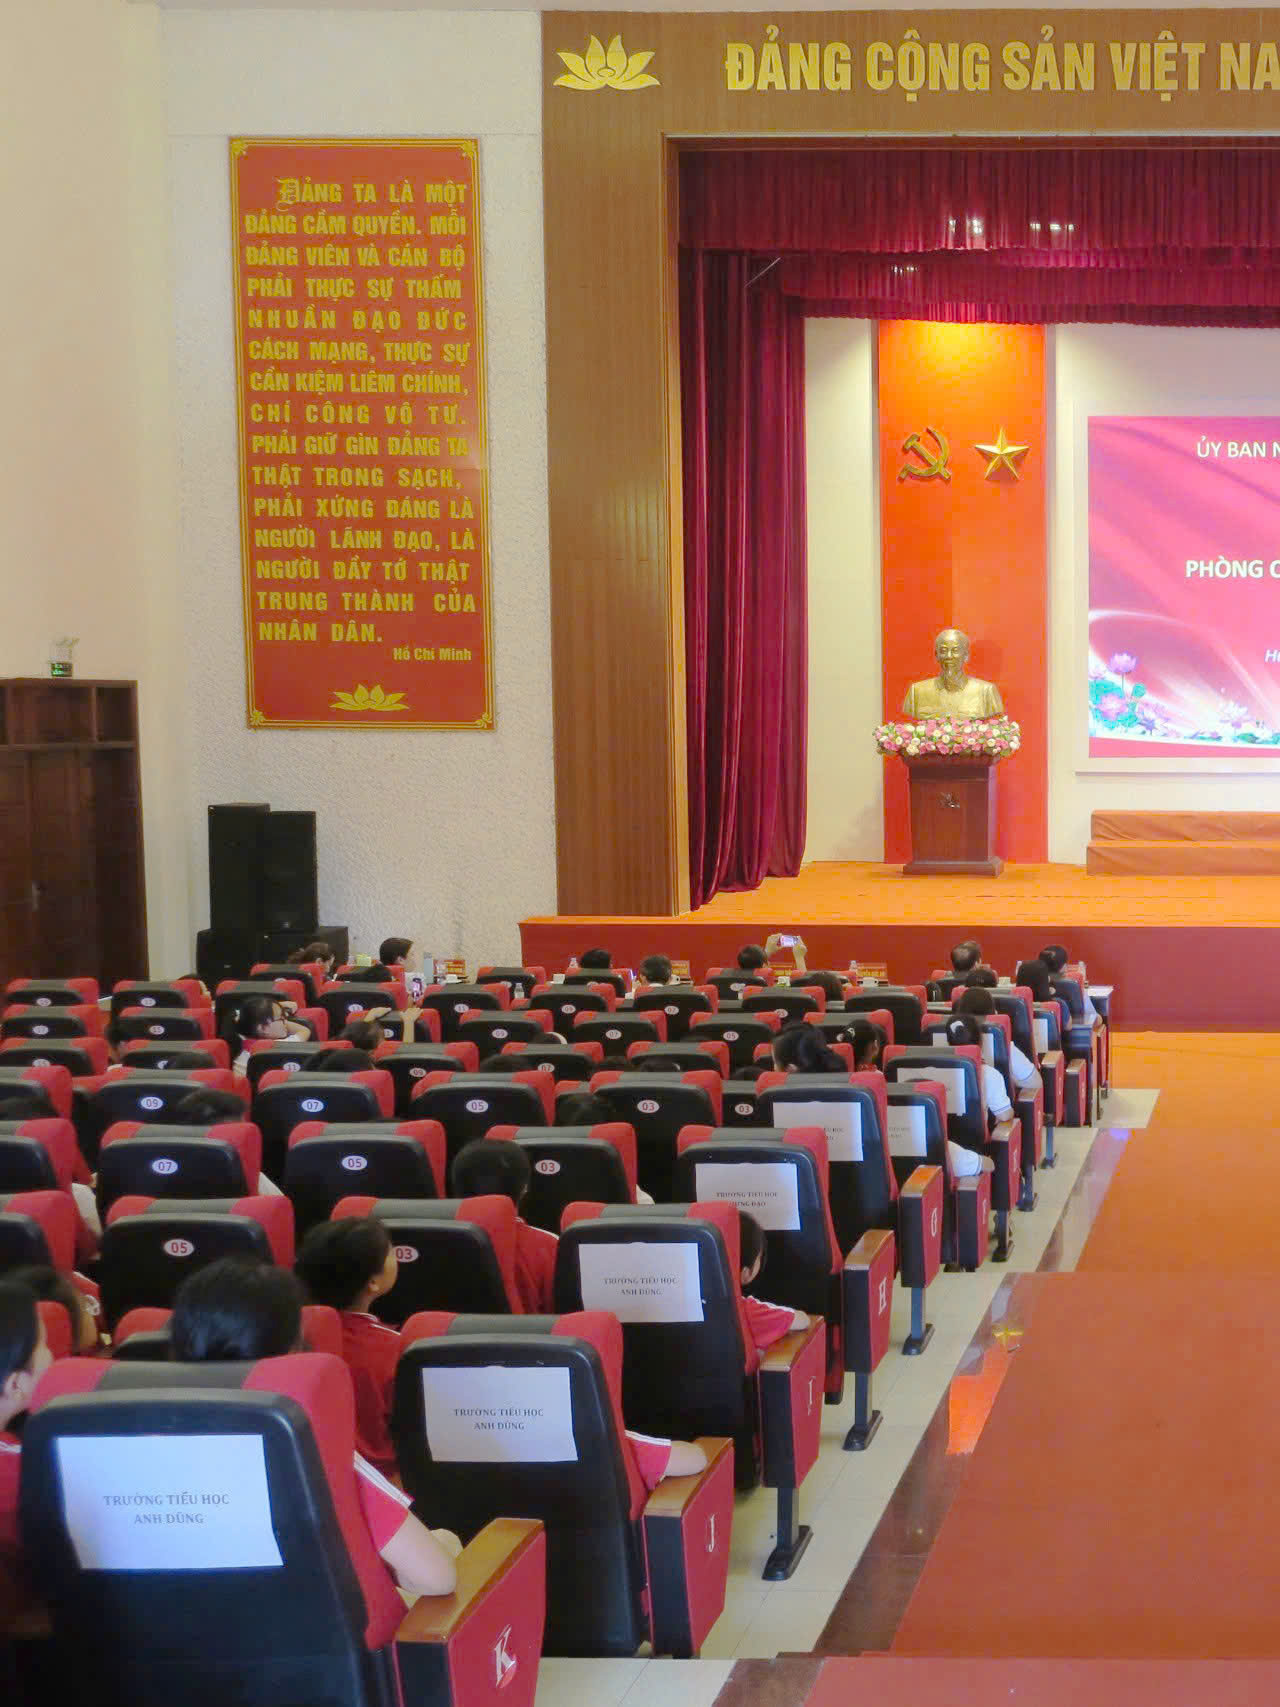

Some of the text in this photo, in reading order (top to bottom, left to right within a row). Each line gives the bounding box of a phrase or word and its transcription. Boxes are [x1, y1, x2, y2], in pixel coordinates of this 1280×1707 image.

[725, 24, 851, 90] ĐẢNG
[866, 28, 990, 102] CỘNG
[1002, 24, 1096, 90] SẢN
[1108, 30, 1206, 102] VIỆT
[354, 184, 376, 202] TA
[389, 180, 413, 202] LÀ
[425, 180, 466, 205] MỘT
[243, 209, 466, 236] ĐẢNG CẦM QUYỀN. MỖI
[245, 241, 464, 271] ĐẢNG VIÊN VÀ CÁN BỘ
[248, 275, 292, 297] PHẢI
[307, 276, 354, 301] THỰC
[368, 276, 394, 301] SỰ
[248, 304, 466, 333] NHUẦN ĐẠO ĐỨC
[249, 337, 470, 366] CÁCH MẠNG, THỰC SỰ
[250, 367, 468, 395] CẦN KIỆM LIÊM CHÍNH,
[250, 401, 291, 422] CHÍ
[306, 403, 369, 423] CÔNG
[385, 402, 412, 424] VÔ
[252, 429, 468, 456] PHẢI GIỮ GÌN ĐẢNG TA
[1197, 435, 1221, 457] ỦY
[1227, 441, 1266, 457] BAN
[252, 463, 462, 491] THẬT TRONG SẠCH,
[254, 492, 474, 518] PHẢI XỨNG ĐÁNG LÀ
[255, 524, 475, 552] NGƯỜI LÃNH ĐẠO, LÀ
[256, 555, 469, 584] NGƯỜI ĐẦY TỚ THẬT
[1186, 555, 1264, 578] PHÒNG
[257, 588, 476, 612] TRUNG THÀNH CỦA
[260, 619, 382, 641] NHÂN DÂN.
[146, 1098, 159, 1109] 09
[306, 1100, 319, 1111] 07
[471, 1101, 484, 1111] 05
[642, 1102, 655, 1112] 03
[738, 1104, 750, 1114] 03
[158, 1161, 172, 1172] 07
[348, 1157, 362, 1169] 05
[540, 1162, 555, 1173] 03
[171, 1242, 188, 1254] 05
[395, 1247, 413, 1260] 03
[474, 1422, 495, 1430] ANH
[134, 1511, 204, 1524] ANH DŨNG
[495, 1624, 517, 1688] K
